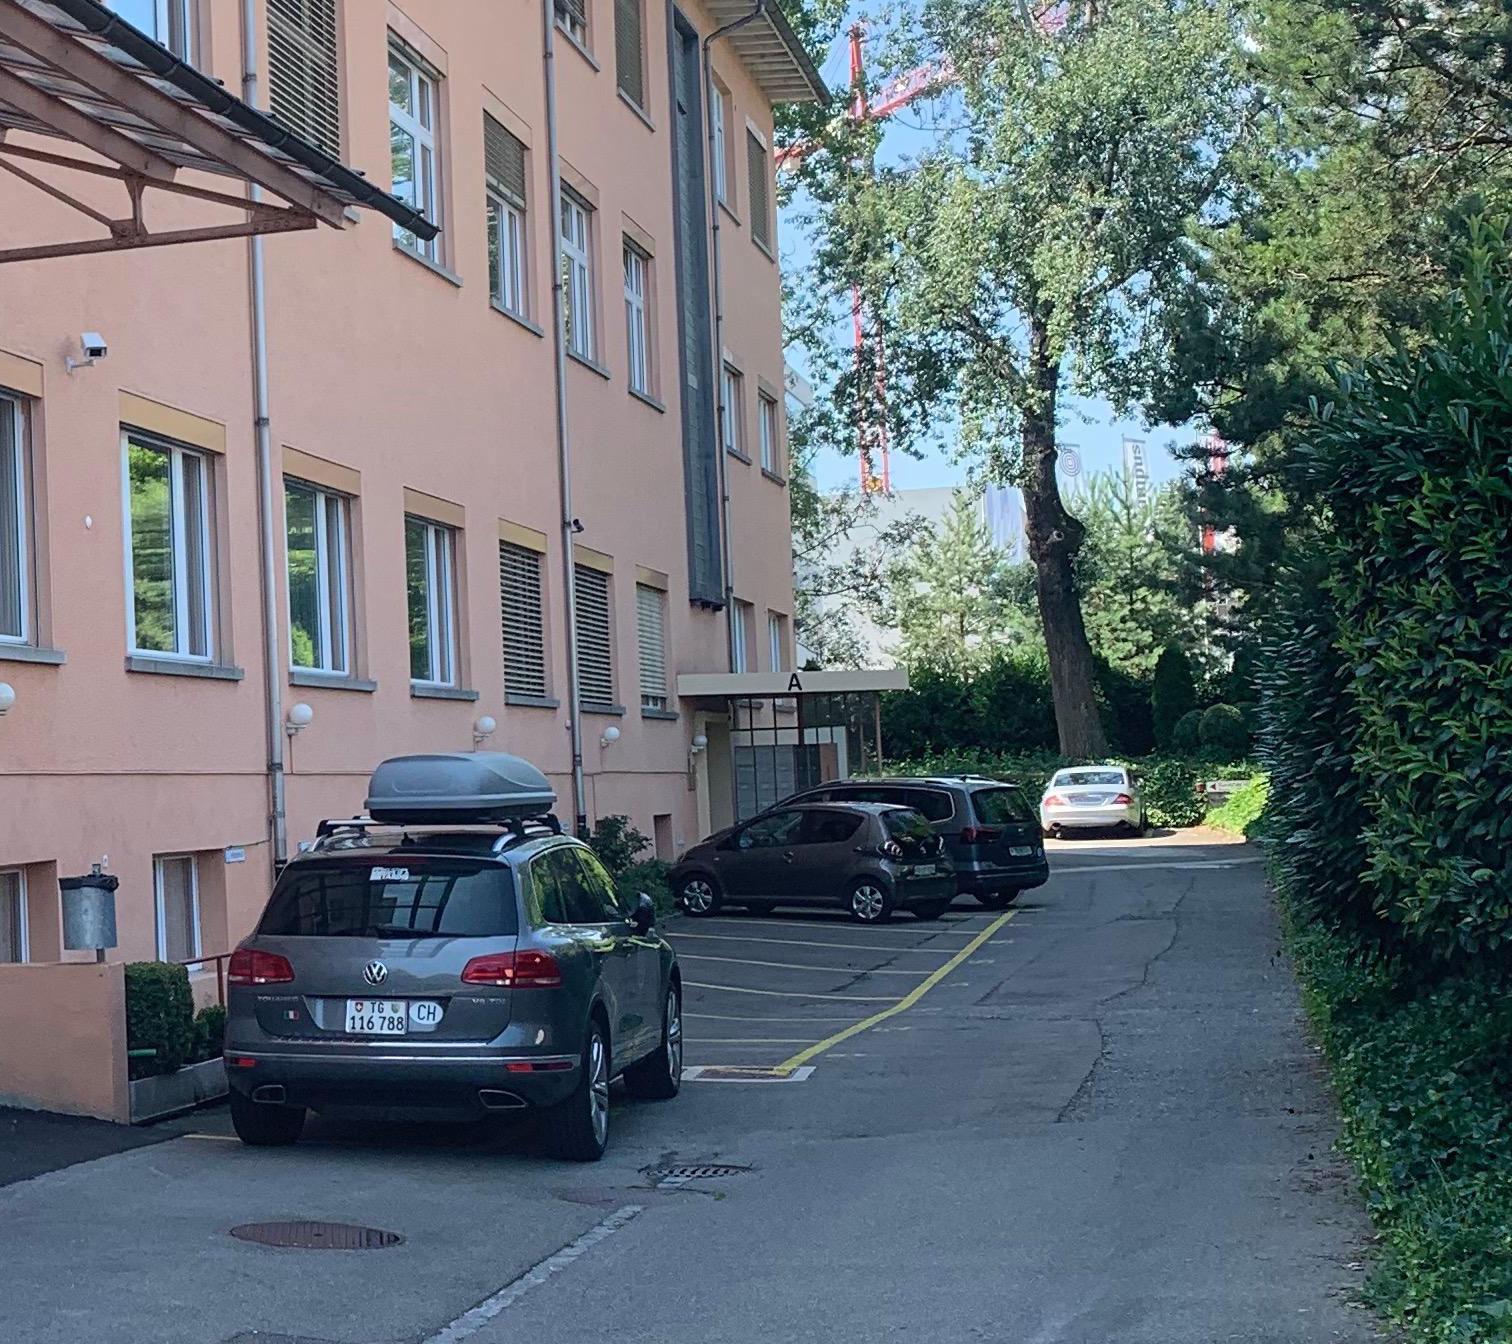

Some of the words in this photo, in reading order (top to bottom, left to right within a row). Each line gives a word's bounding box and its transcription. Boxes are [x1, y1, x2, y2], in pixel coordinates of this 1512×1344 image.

[788, 673, 802, 691] A
[371, 1002, 385, 1014] TG
[417, 1004, 436, 1022] CH
[350, 1016, 375, 1031] 116
[379, 1016, 404, 1032] 788
